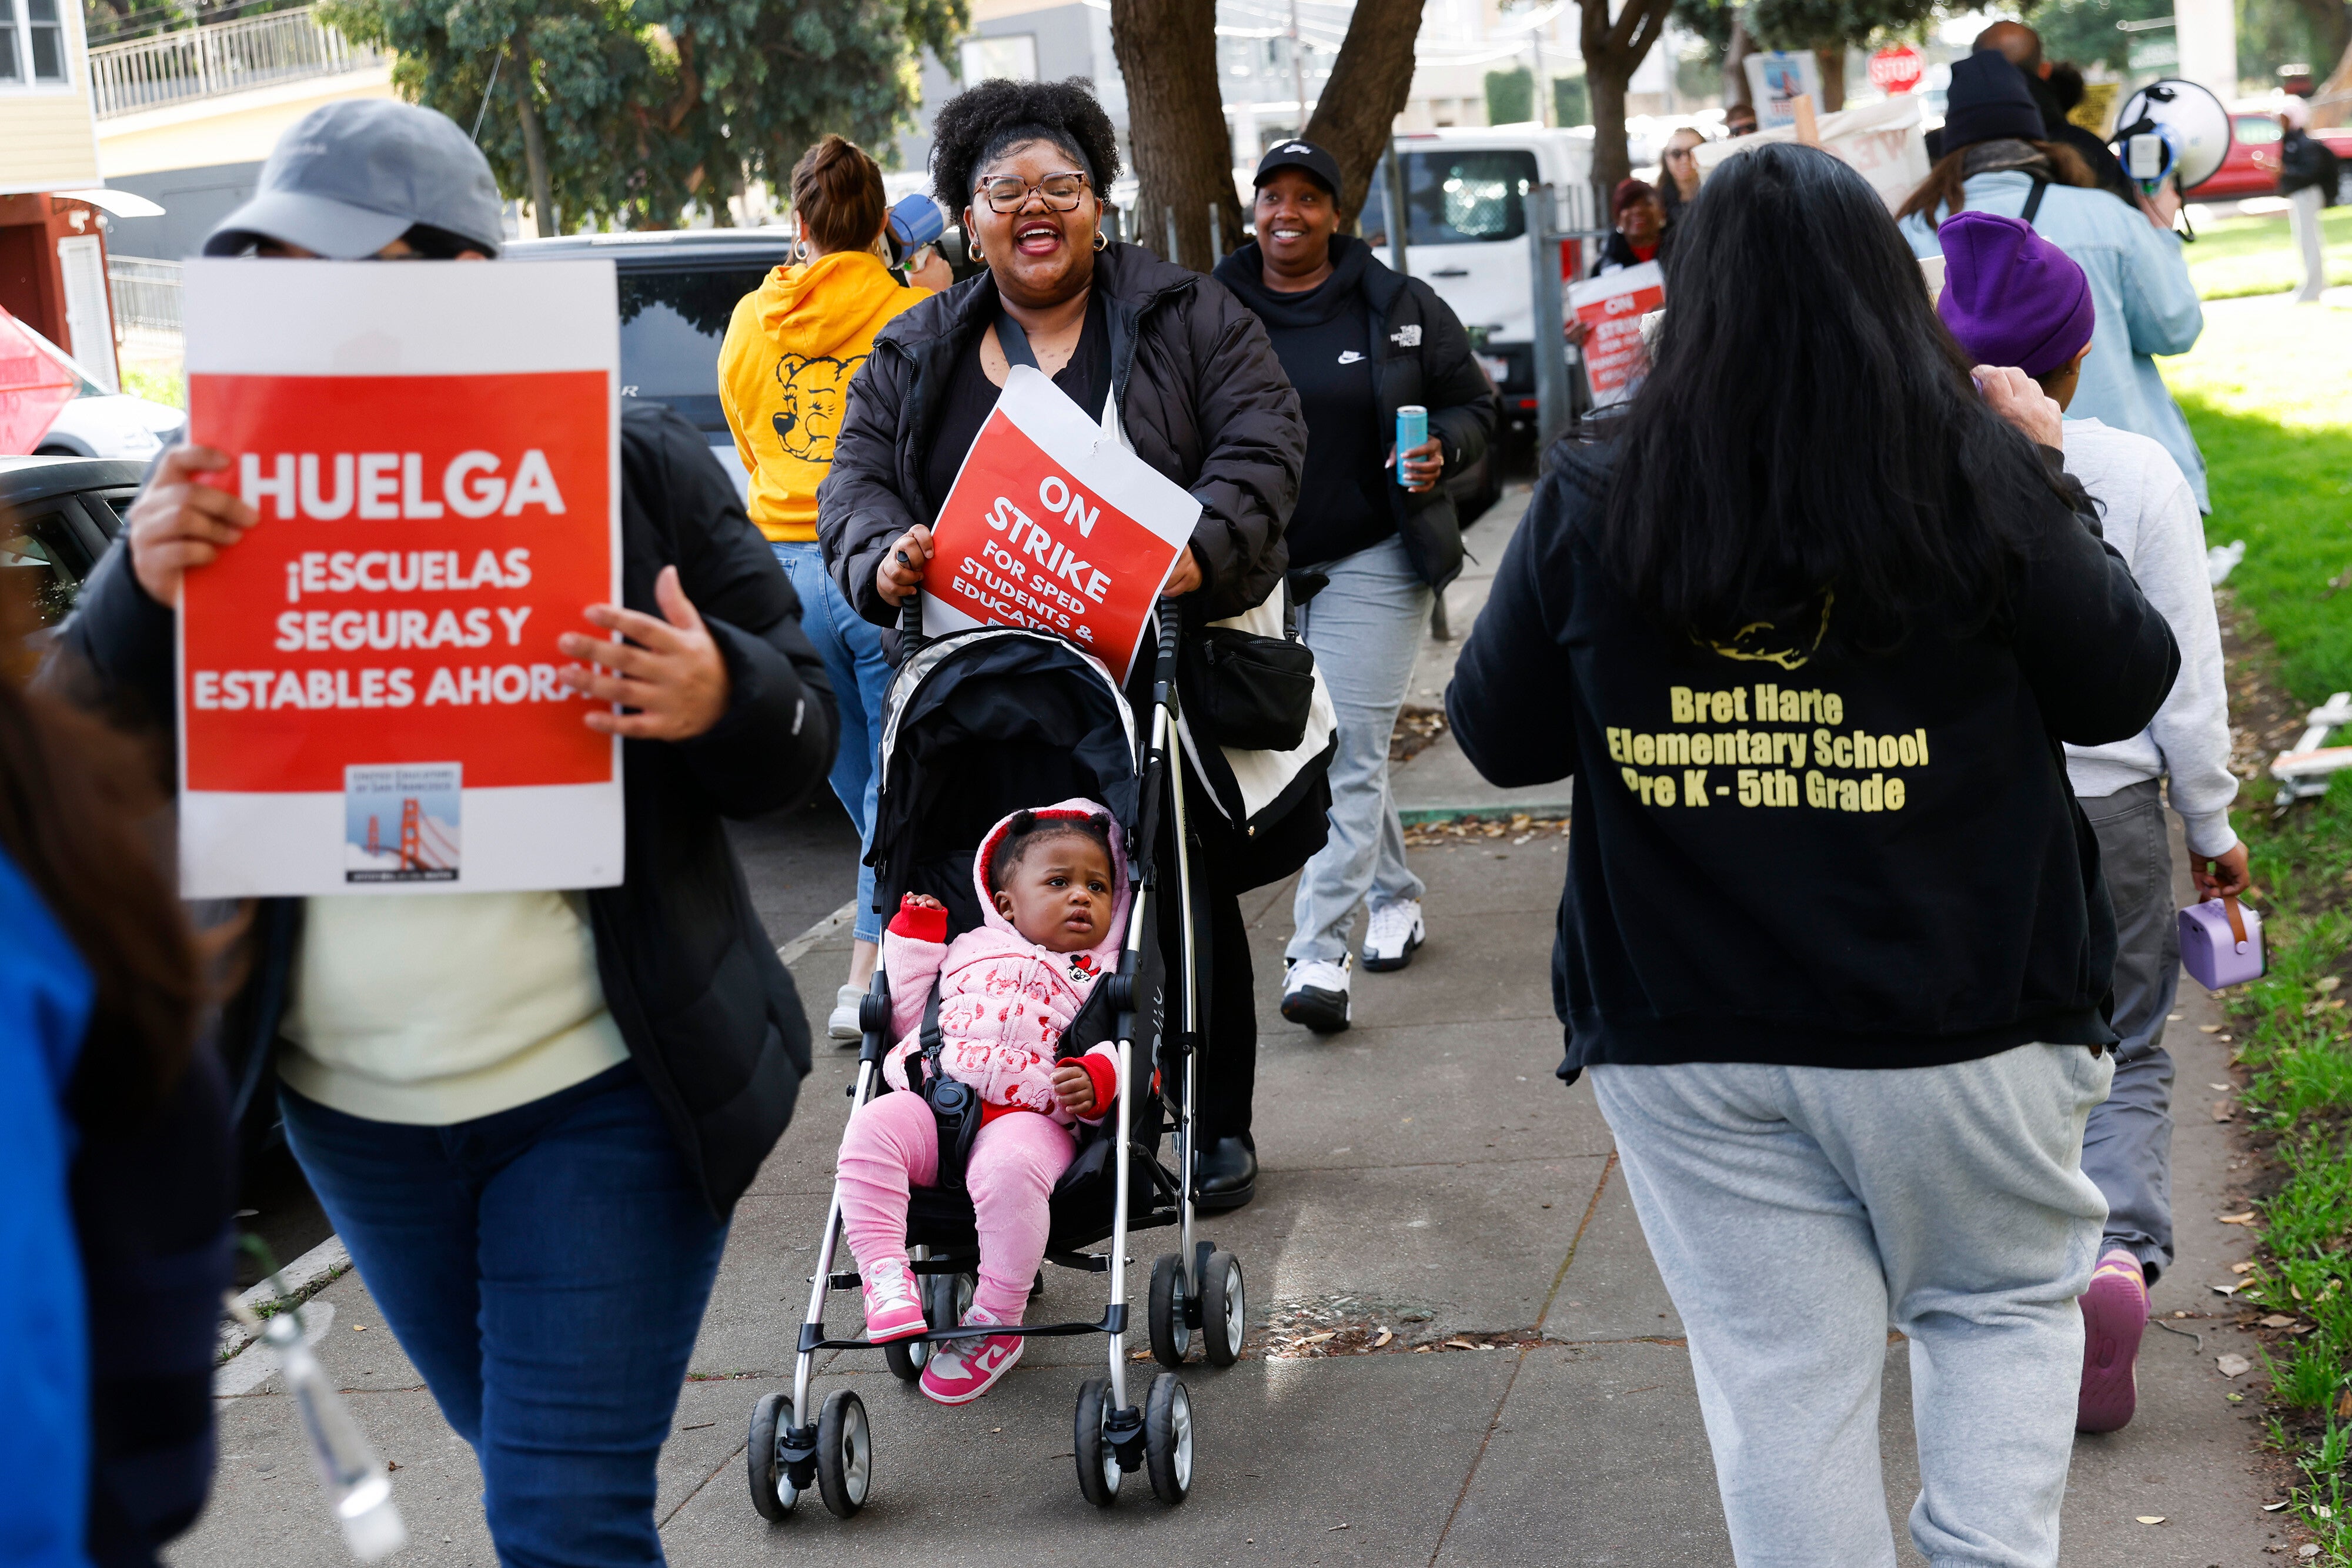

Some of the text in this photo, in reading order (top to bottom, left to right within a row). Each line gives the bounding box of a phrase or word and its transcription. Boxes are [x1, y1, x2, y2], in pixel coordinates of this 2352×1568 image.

[1870, 56, 1918, 82] STOP
[239, 449, 567, 520] HUELGA
[1039, 475, 1101, 539] ON
[286, 547, 532, 603] ¡ESCUELAS
[984, 496, 1112, 604] STRIKE
[960, 557, 1094, 644] STUDENTS &
[982, 539, 1085, 615] FOR SPED
[275, 606, 532, 651] SEGURAS Y
[194, 668, 416, 710] ESTABLES
[1670, 683, 1843, 726] Bret Harte
[1606, 726, 1929, 769] Elementary School
[1683, 768, 1710, 808] K
[1737, 768, 1799, 808] 5th
[1805, 770, 1906, 813] Grade
